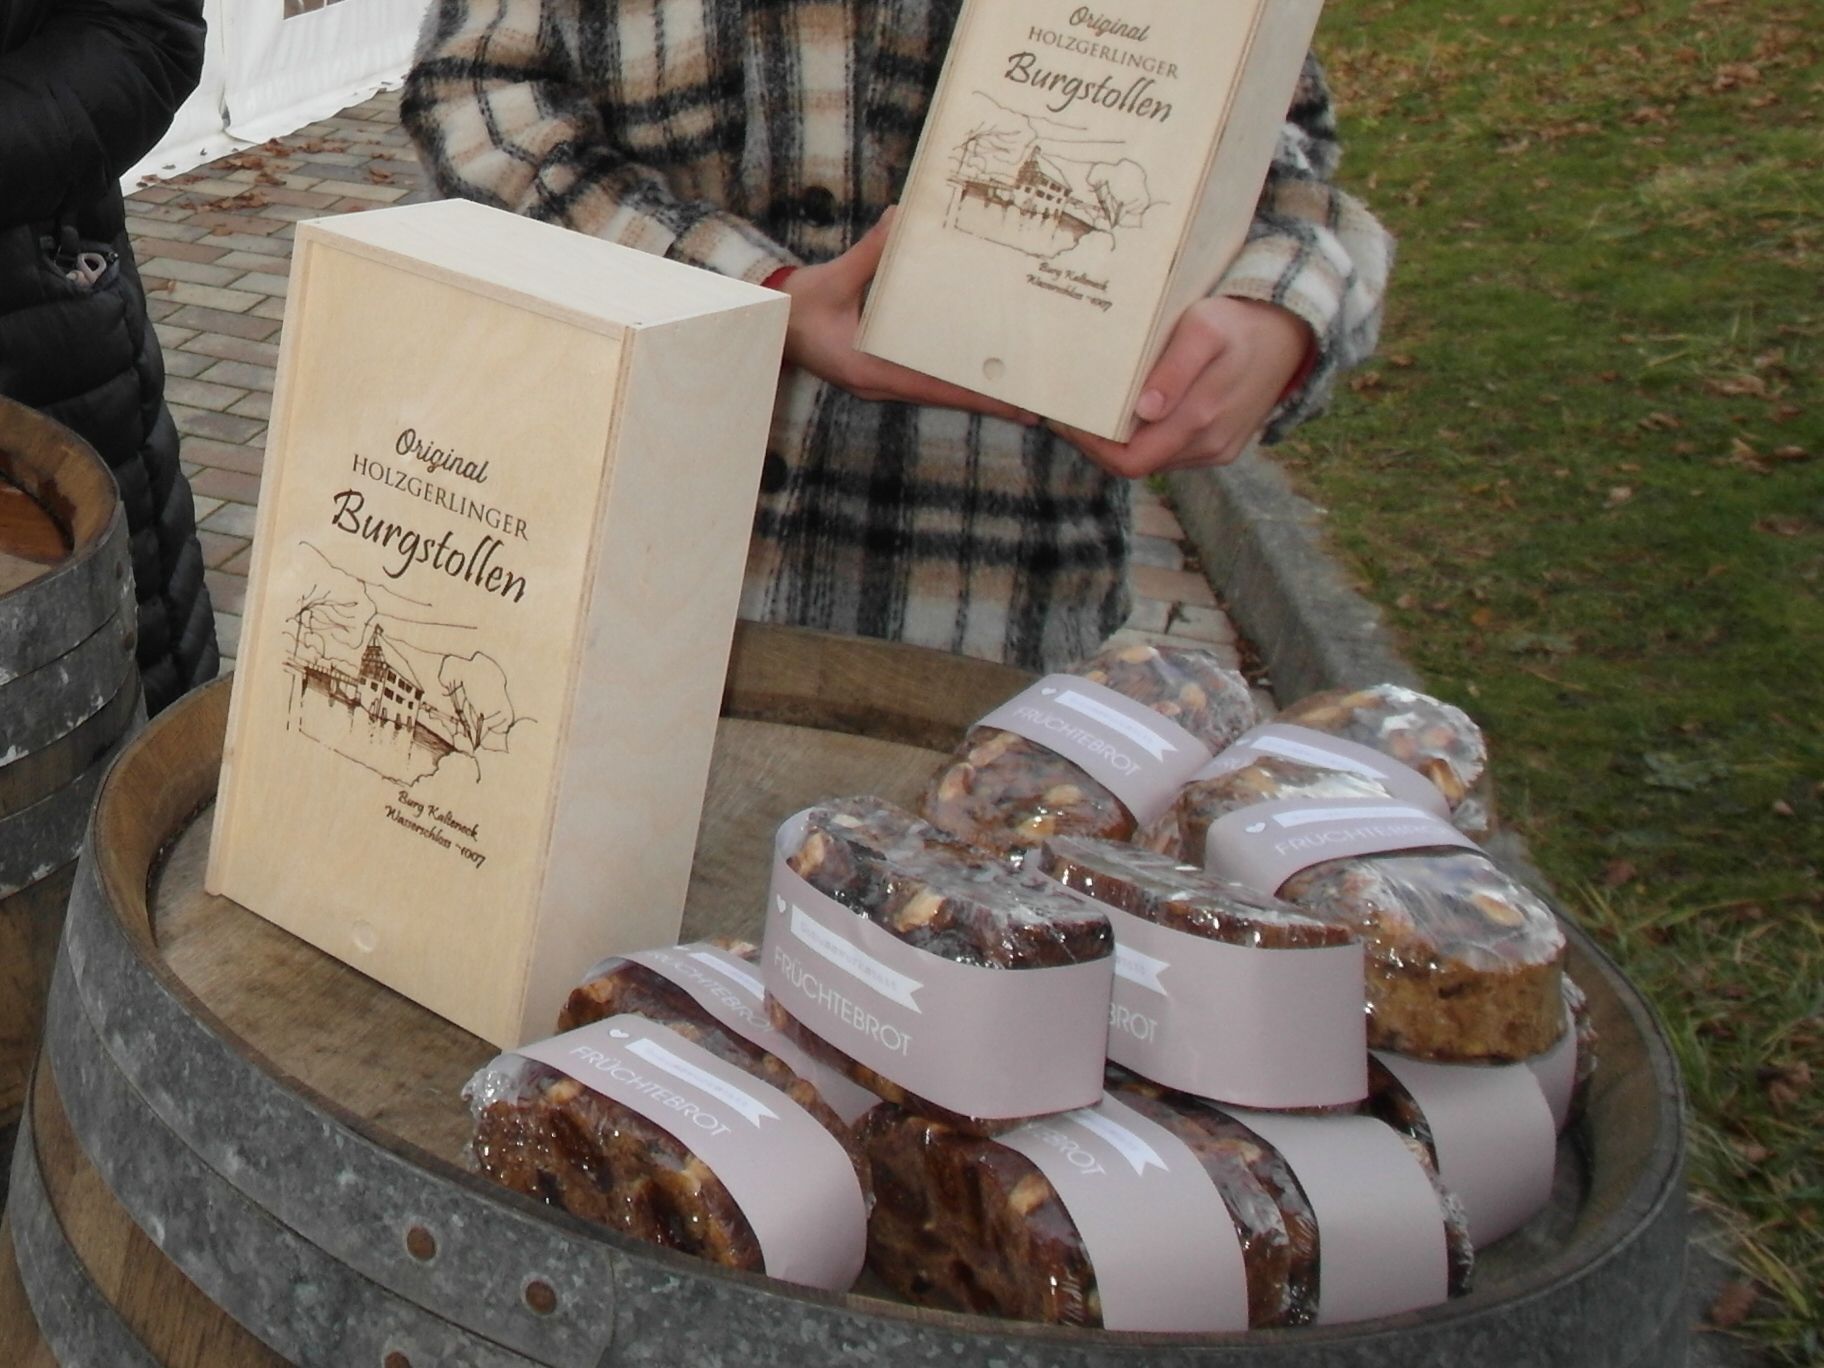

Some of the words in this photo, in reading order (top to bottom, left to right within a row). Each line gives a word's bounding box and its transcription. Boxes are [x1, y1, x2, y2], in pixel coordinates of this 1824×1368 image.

[1027, 25, 1179, 80] HOLZGERLINGER
[1069, 5, 1152, 42] Original
[1004, 50, 1173, 123] Burgstollen
[1038, 262, 1062, 281] Burg
[395, 427, 489, 484] Original
[352, 453, 530, 542] HOLZGERLINGER
[332, 487, 527, 603] Burgstollen
[398, 790, 425, 818] Burg
[428, 805, 479, 842] Kalteneck
[774, 945, 913, 1057] FRÜCHTEBROT
[570, 1043, 733, 1139] FRÜCHTEBROT
